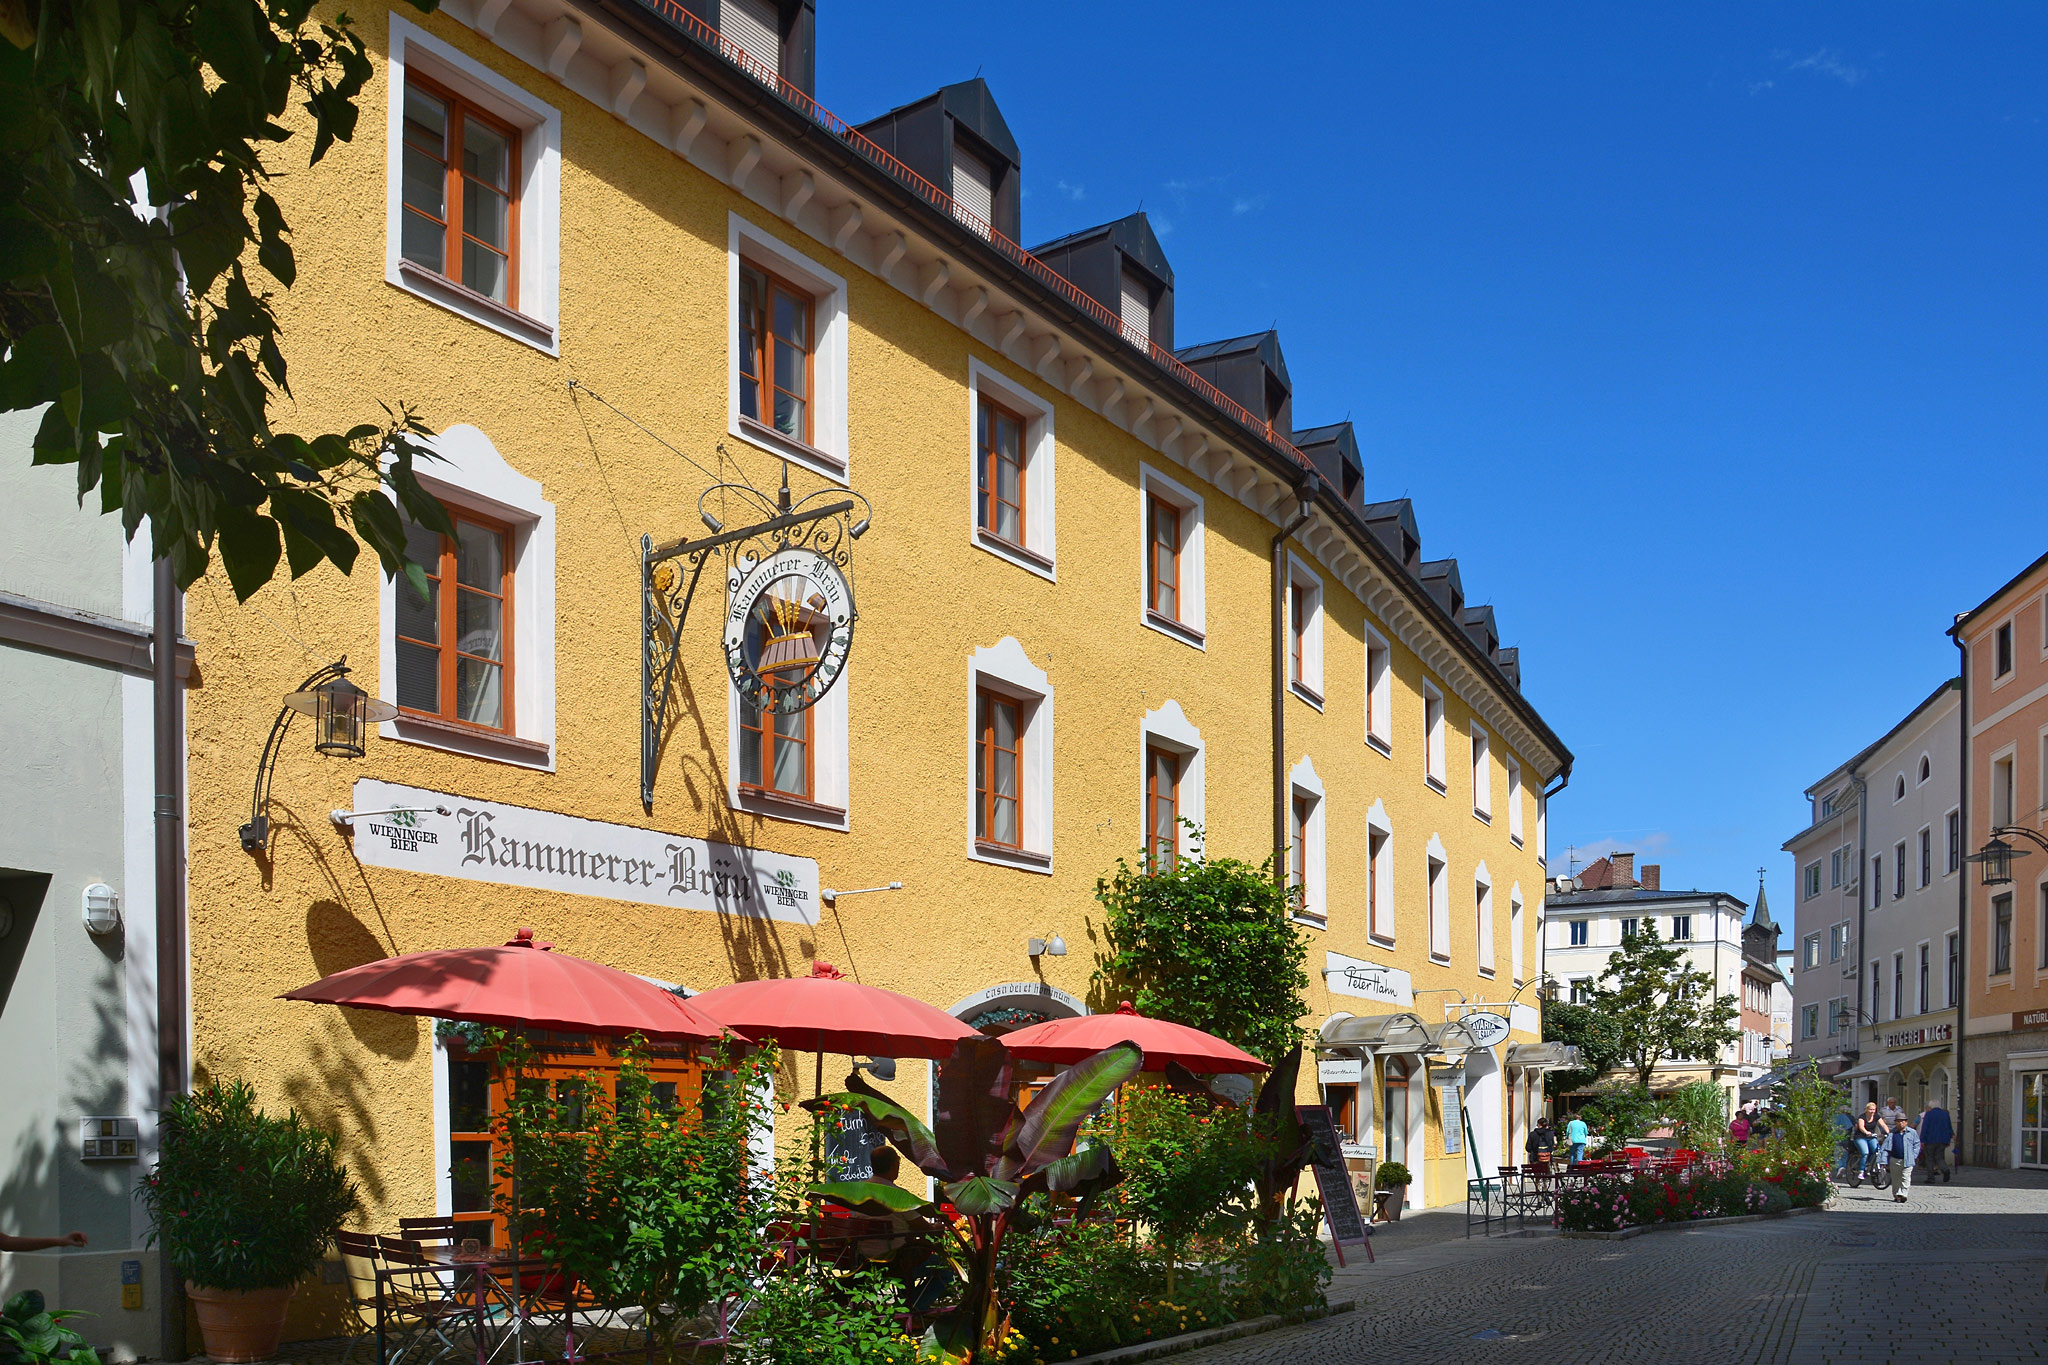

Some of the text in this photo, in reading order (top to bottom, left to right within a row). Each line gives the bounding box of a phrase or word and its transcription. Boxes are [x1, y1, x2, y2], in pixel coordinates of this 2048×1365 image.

[369, 823, 438, 844] WIENINGER
[390, 838, 418, 852] BIER
[456, 807, 751, 901] Kammerer-Bräu
[763, 885, 808, 900] WIENINGER
[777, 896, 796, 907] BIER
[1344, 966, 1398, 997] Peter Hahn
[985, 986, 1007, 998] casa
[1009, 983, 1022, 993] dei
[1024, 983, 1032, 993] et
[1470, 1019, 1496, 1030] AVARIA
[120, 1143, 133, 1153] 21
